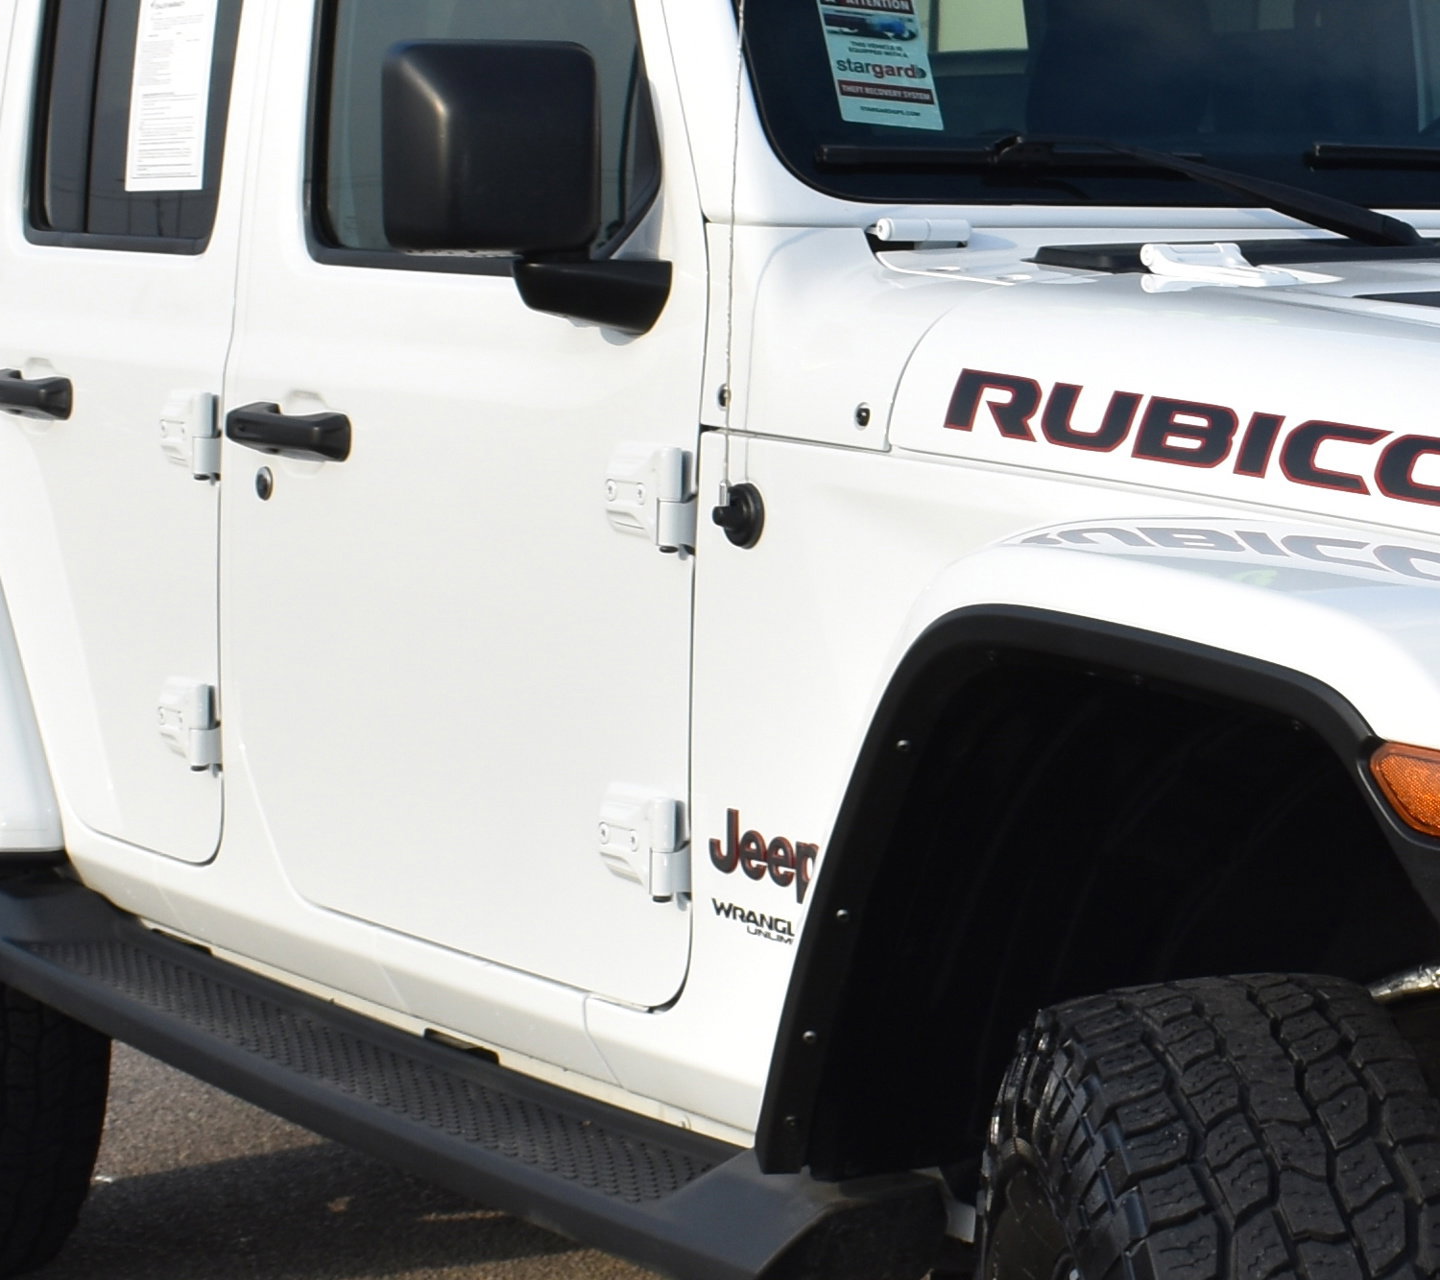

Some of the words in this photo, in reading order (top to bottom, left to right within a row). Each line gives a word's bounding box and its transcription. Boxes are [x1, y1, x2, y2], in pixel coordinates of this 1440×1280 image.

[836, 58, 915, 78] stargard
[711, 897, 796, 937] WRANGL
[747, 926, 794, 945] UNLIM
